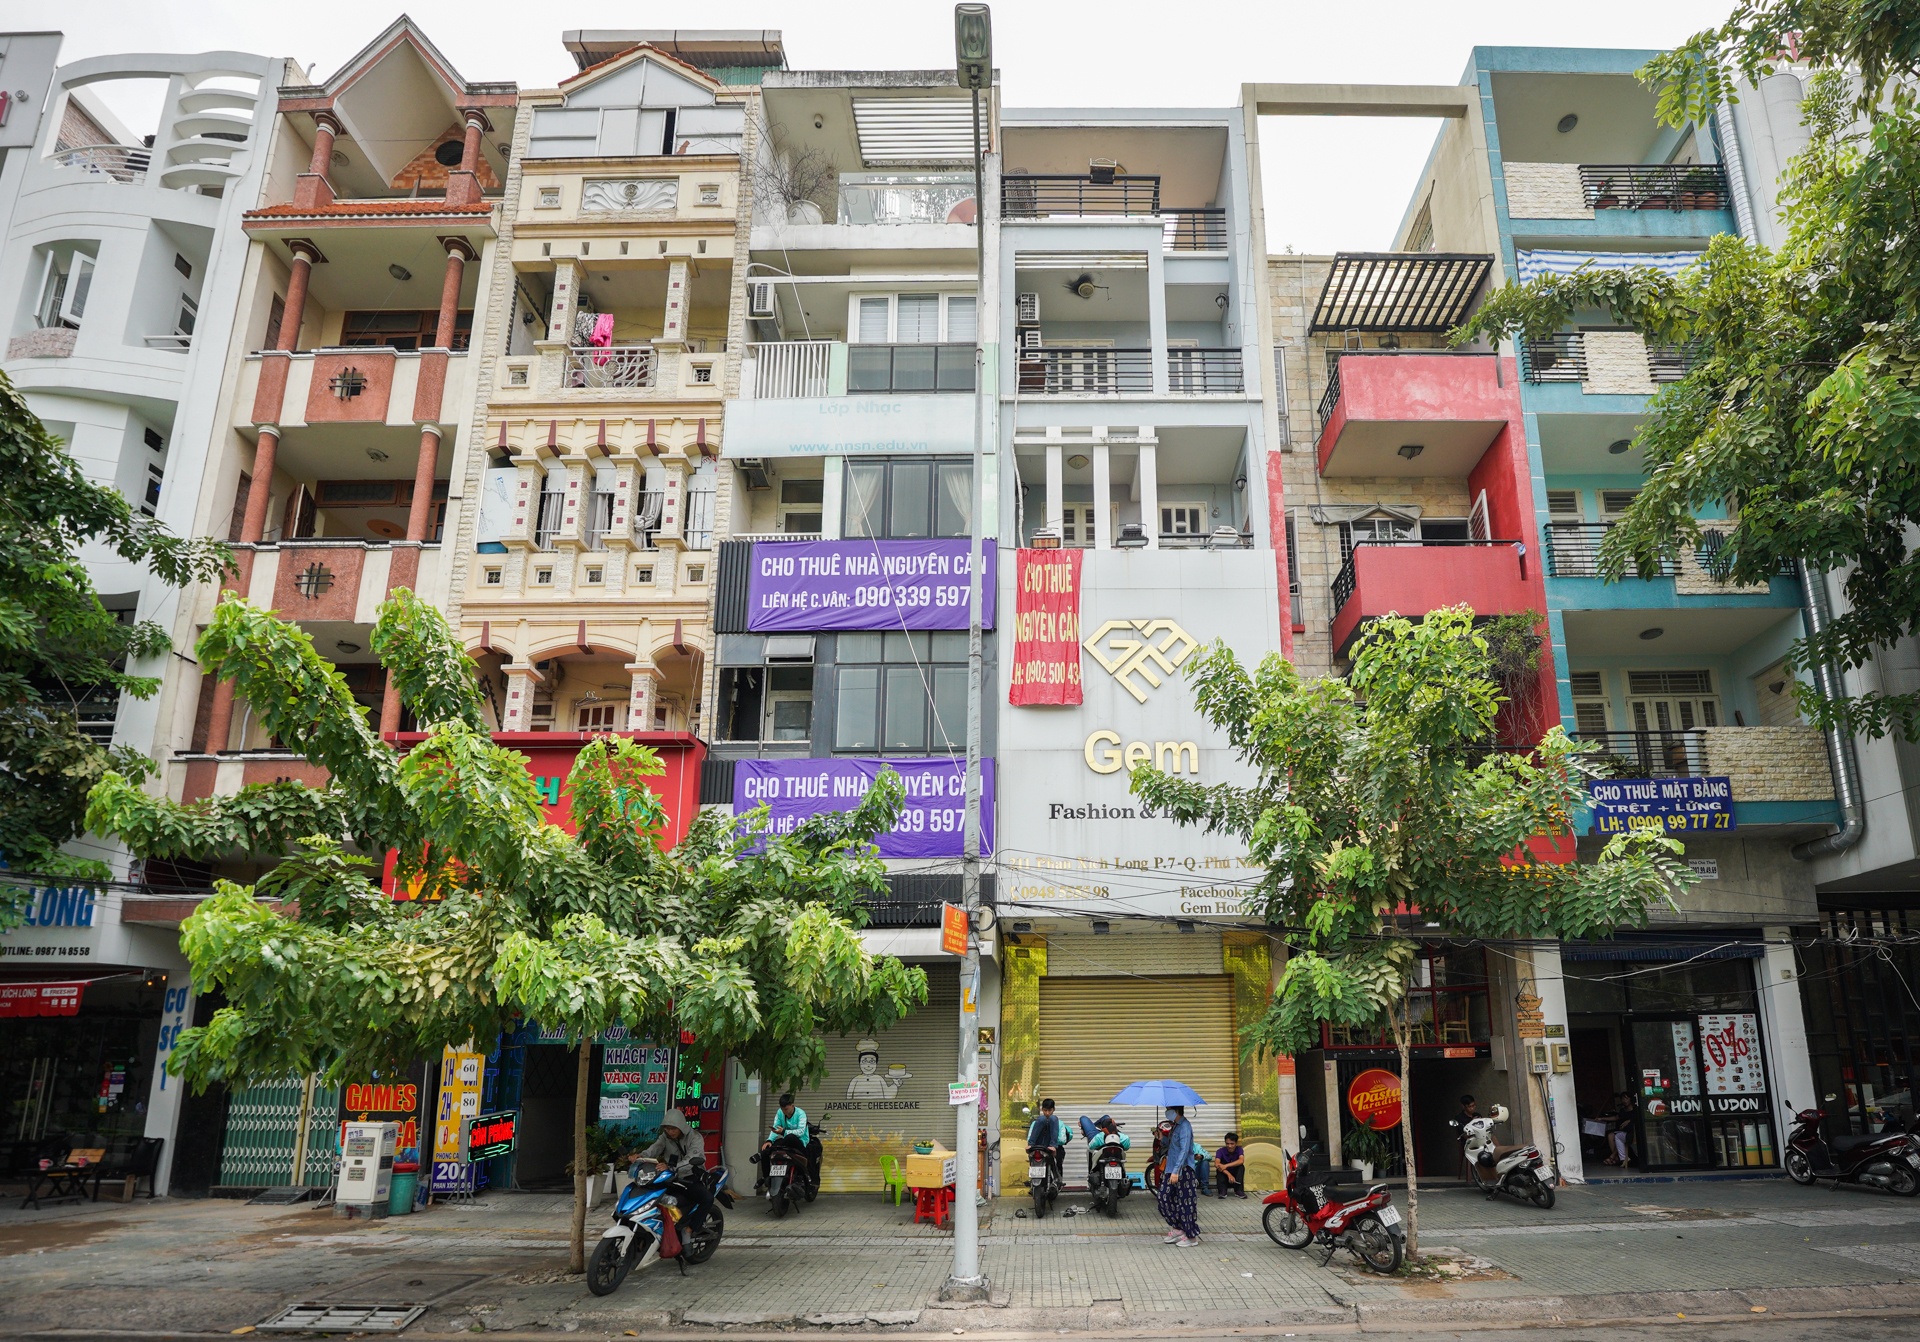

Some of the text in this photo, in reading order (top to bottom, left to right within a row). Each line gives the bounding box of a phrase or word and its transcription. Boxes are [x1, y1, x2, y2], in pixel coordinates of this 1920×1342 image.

[761, 557, 795, 577] CHO
[799, 553, 841, 577] THUÊ
[845, 553, 879, 576] NHÀ
[884, 552, 949, 576] NGUYÊN
[1024, 555, 1073, 593] CHO THUÊ
[762, 585, 983, 611] LIÊN HỆ C.VÂN: 090 339 597
[1015, 603, 1056, 643] NGUYÊN
[1025, 659, 1047, 684] 0902
[1049, 661, 1066, 685] 500
[1067, 662, 1081, 686] 43
[1084, 729, 1199, 775] Gem
[744, 776, 780, 798] CHO
[784, 772, 829, 798] THUÊ
[833, 771, 869, 797] NHÀ
[1594, 785, 1621, 801] CHO
[1623, 781, 1659, 800] THUÊ
[1662, 782, 1689, 802] MẶT
[1049, 803, 1136, 820] Fashion
[1599, 813, 1730, 832] LH: 0909 99 77 27
[1114, 857, 1149, 873] Long
[1021, 886, 1056, 899] 0948
[1093, 886, 1110, 899] 98
[1180, 886, 1247, 898] Facebook:
[1180, 902, 1212, 914] Gem
[0, 946, 33, 956] OTLINE:
[35, 946, 56, 956] 0987
[606, 1044, 647, 1064] KHÁCH
[463, 1064, 475, 1073] 60
[604, 1070, 641, 1083] VÀNG
[346, 1083, 417, 1112] GAMES
[462, 1098, 475, 1107] 80
[701, 1095, 719, 1109] 07
[824, 1102, 862, 1110] JAPANESE
[868, 1102, 920, 1110] CHEESECAKE
[1352, 1087, 1401, 1111] Pasta
[1719, 1098, 1760, 1111] UDON
[471, 1118, 514, 1148] CÒN PHÒNG
[436, 1162, 470, 1180] 207
